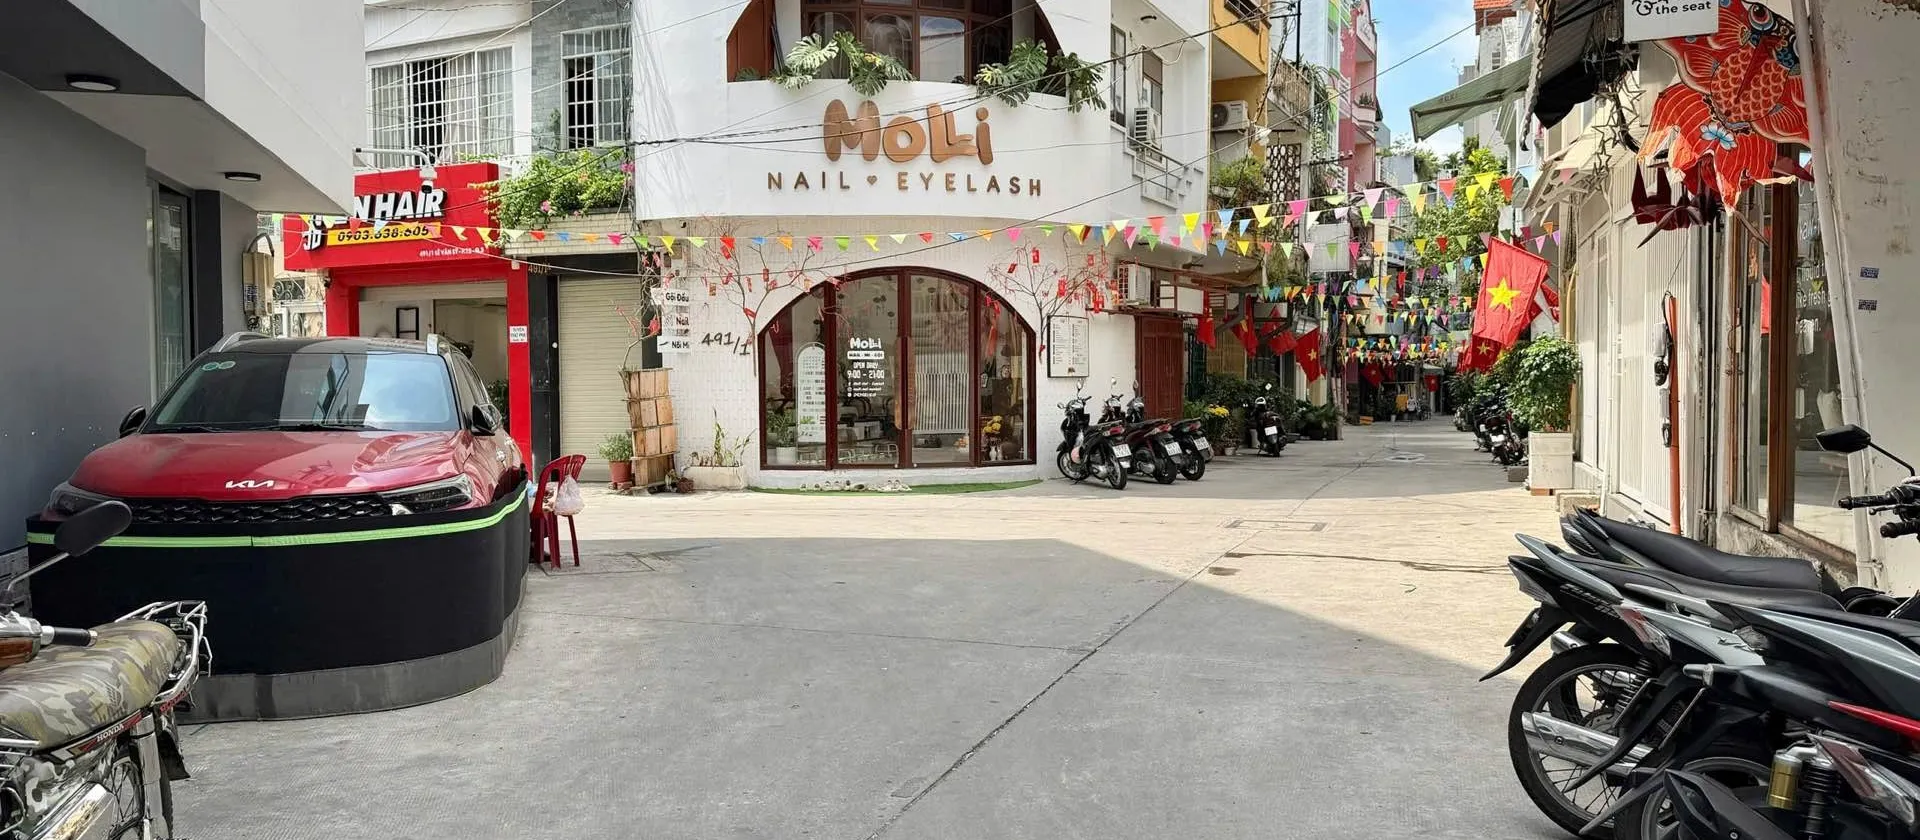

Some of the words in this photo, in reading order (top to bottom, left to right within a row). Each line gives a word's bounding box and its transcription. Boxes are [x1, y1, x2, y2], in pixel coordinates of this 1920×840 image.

[1655, 5, 1678, 15] the
[1682, 1, 1712, 12] seat
[767, 171, 850, 190] NAIL
[897, 171, 1041, 197] EYELASH
[374, 188, 446, 221] HAIR
[676, 316, 689, 326] Nail
[701, 331, 751, 356] 491/1
[853, 361, 865, 369] OPEN
[847, 369, 861, 379] 9:00
[868, 369, 885, 379] 21:00
[225, 480, 275, 489] KIA
[96, 722, 125, 743] HONDA
